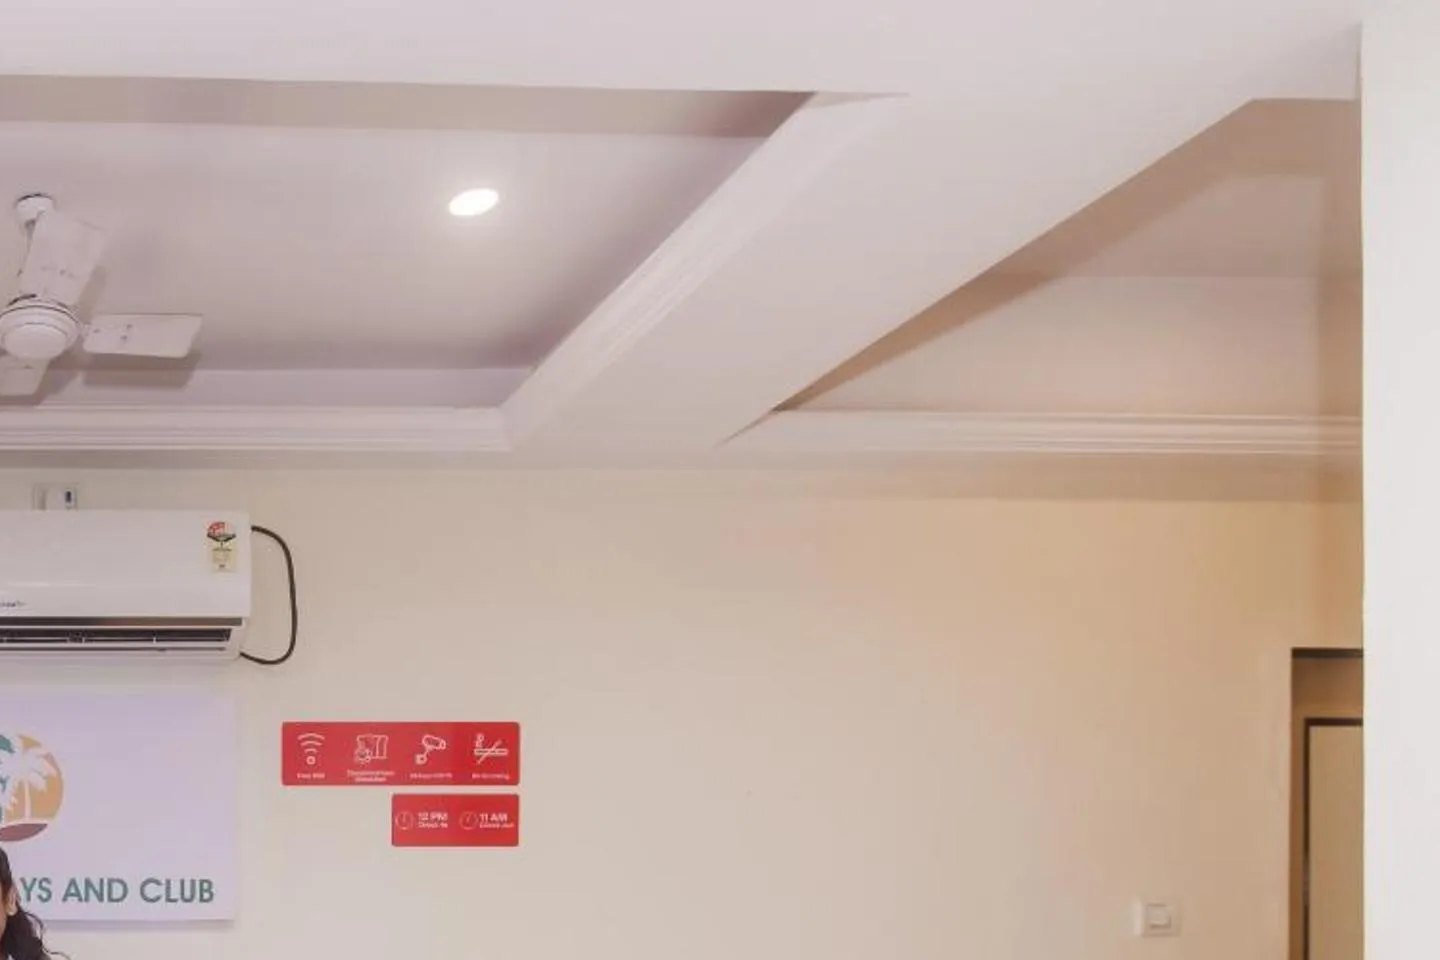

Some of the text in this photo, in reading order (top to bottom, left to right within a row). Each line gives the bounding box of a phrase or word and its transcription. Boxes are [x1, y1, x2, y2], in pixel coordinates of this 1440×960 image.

[430, 811, 448, 822] PM
[479, 812, 508, 822] 11 AM
[62, 877, 129, 903] AND
[139, 878, 215, 904] CLUB
